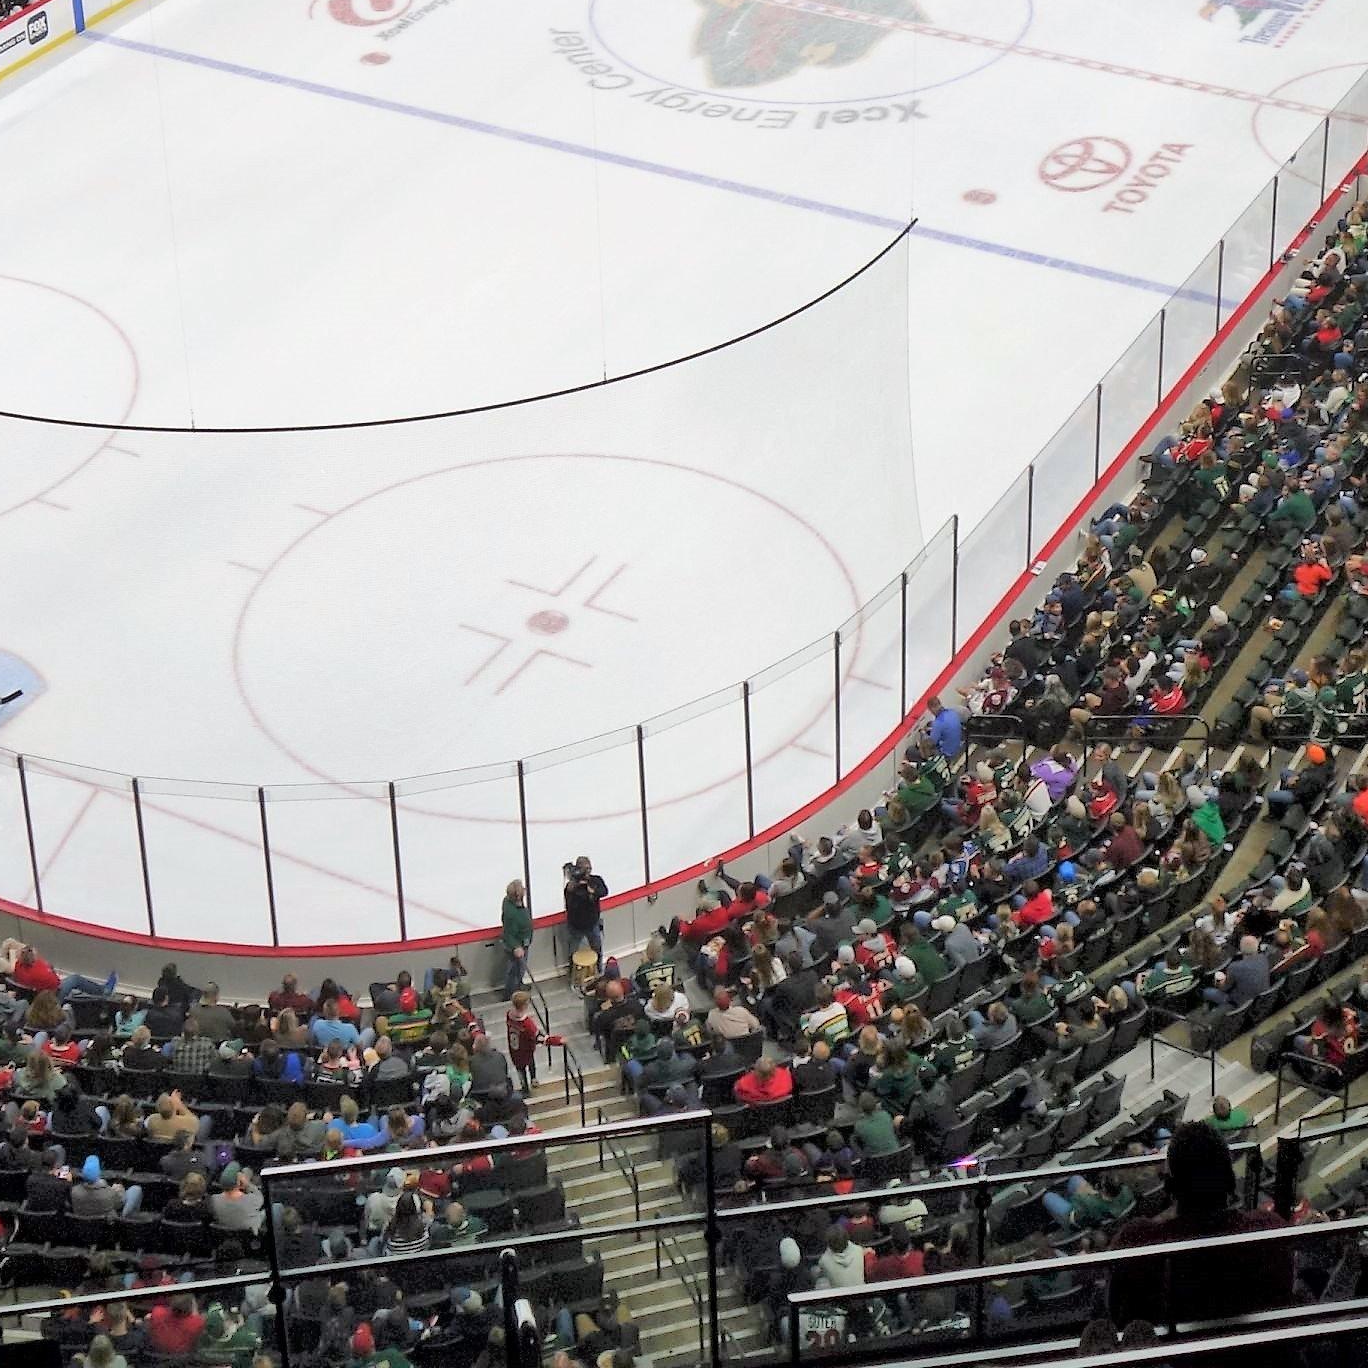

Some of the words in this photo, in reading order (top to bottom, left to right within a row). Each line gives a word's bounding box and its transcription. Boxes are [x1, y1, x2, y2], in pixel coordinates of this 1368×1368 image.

[550, 28, 633, 90] Center
[630, 87, 798, 130] Energy
[815, 100, 927, 130] Xcel
[1102, 144, 1194, 213] TOYOTA
